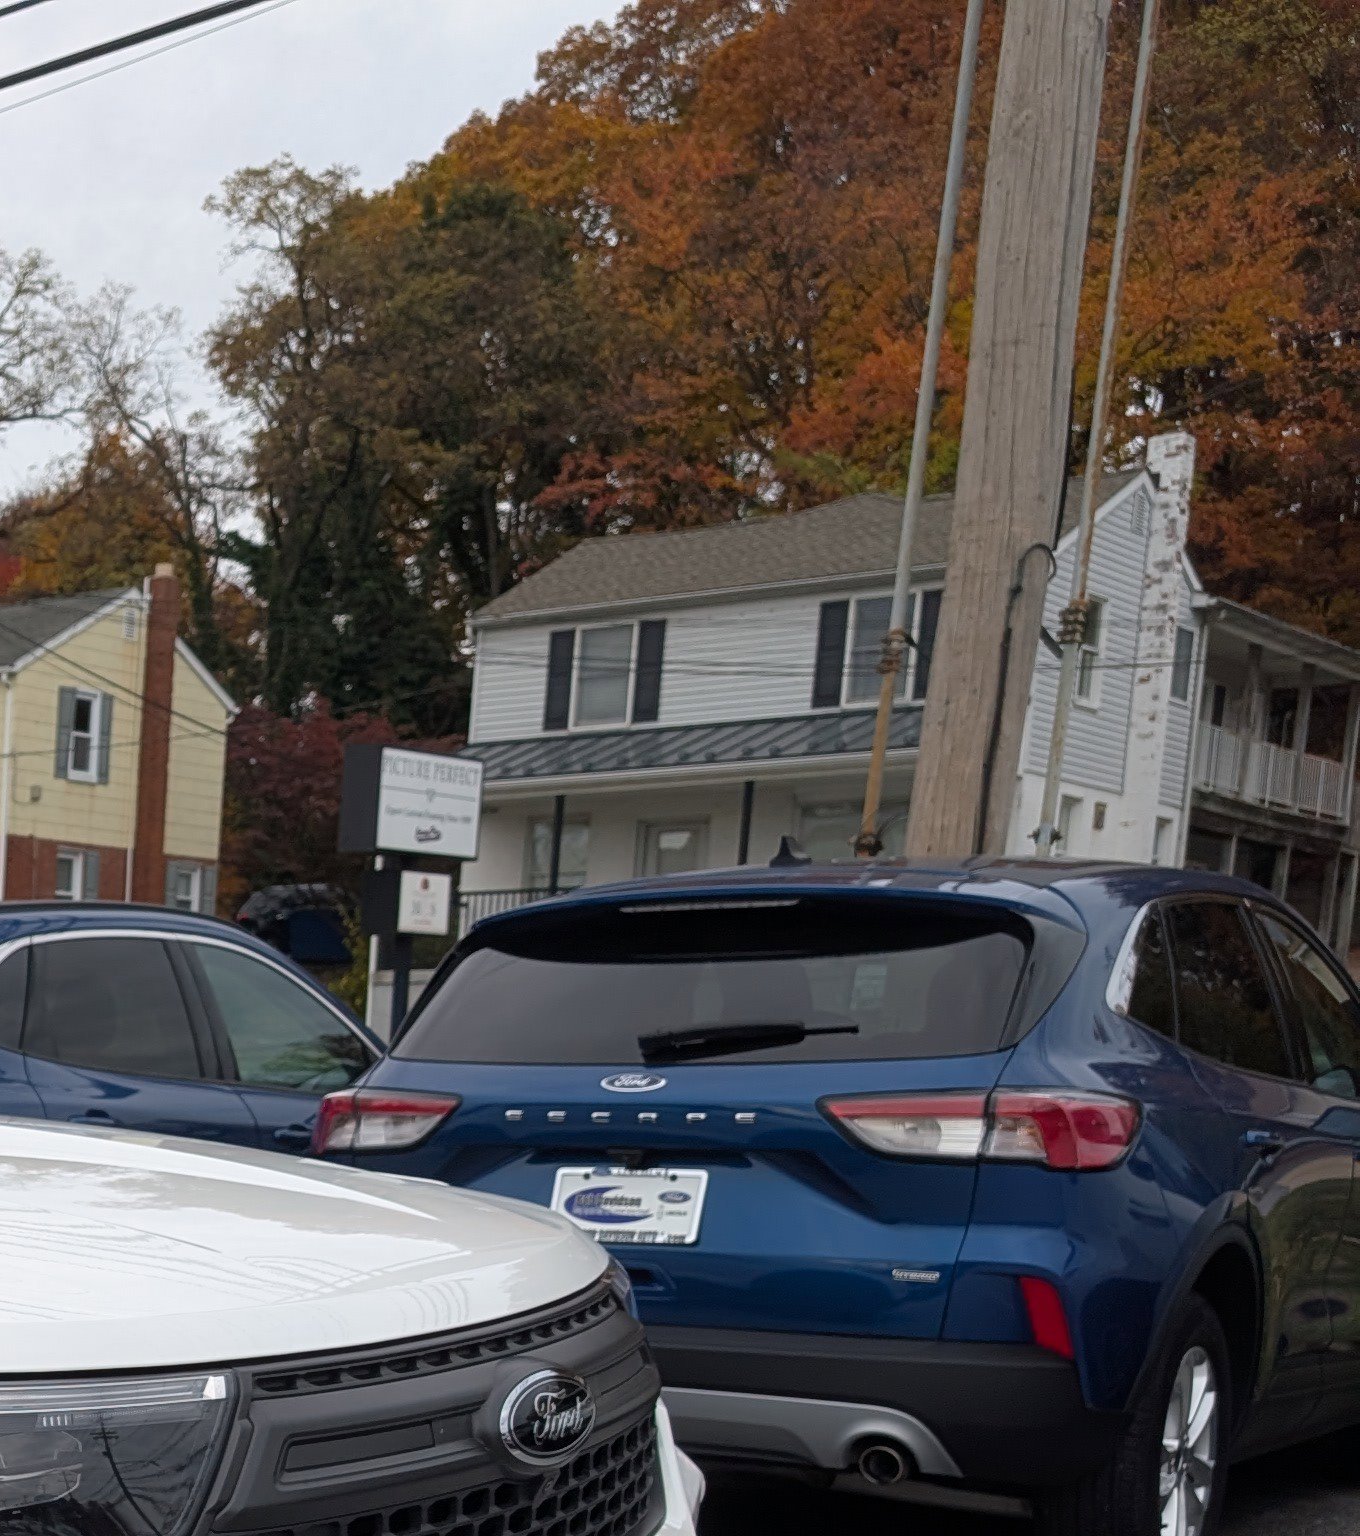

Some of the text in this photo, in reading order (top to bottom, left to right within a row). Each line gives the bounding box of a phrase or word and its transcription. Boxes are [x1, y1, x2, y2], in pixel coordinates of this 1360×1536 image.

[382, 755, 480, 786] PICTURE PERFECT
[613, 1073, 653, 1088] Ford
